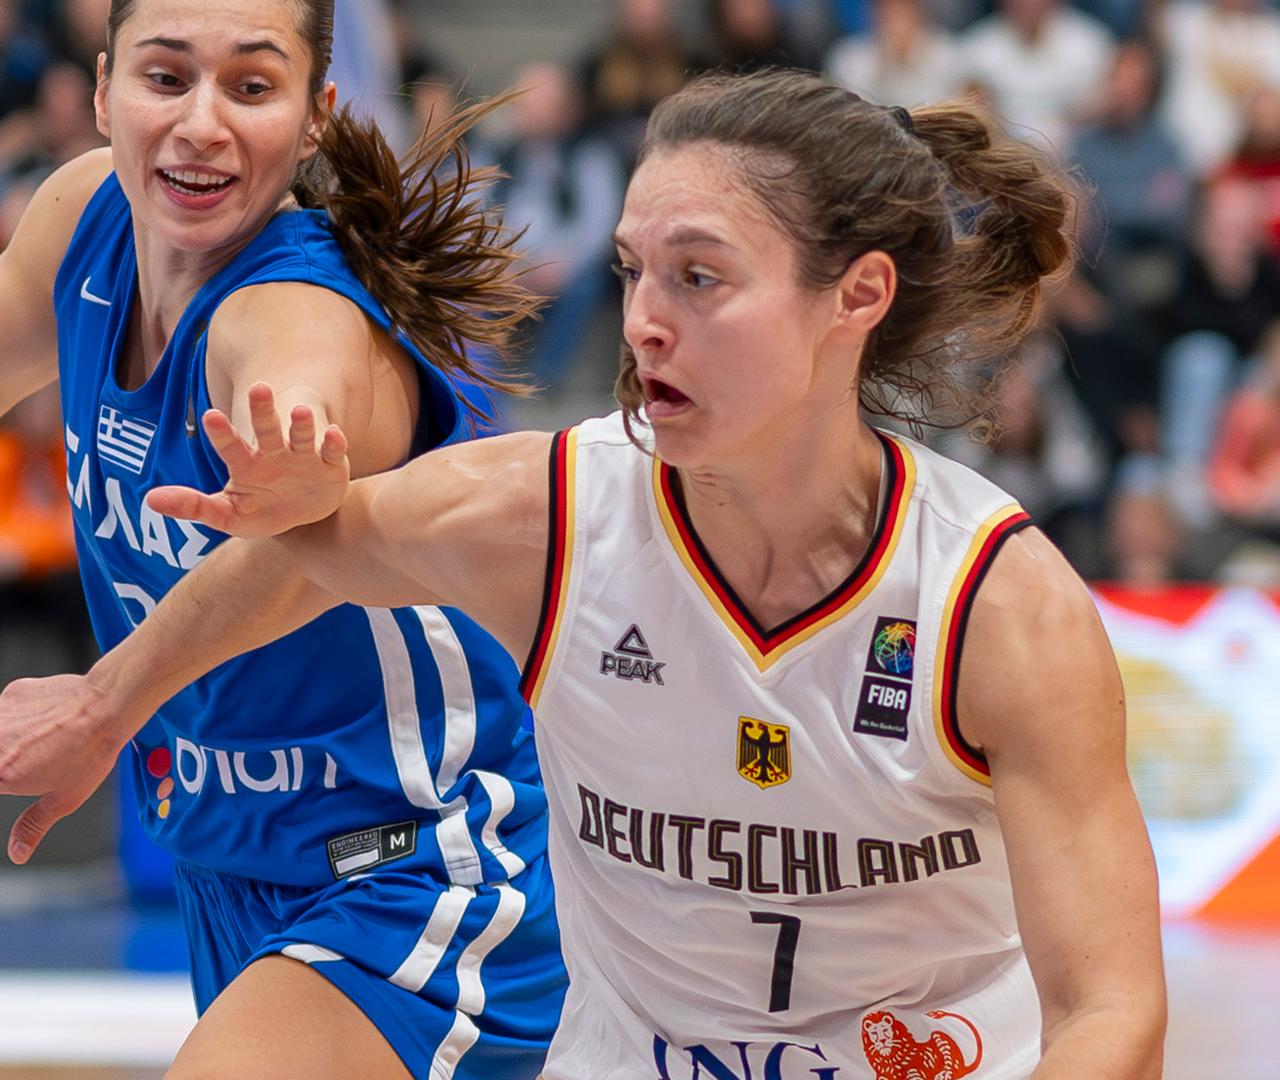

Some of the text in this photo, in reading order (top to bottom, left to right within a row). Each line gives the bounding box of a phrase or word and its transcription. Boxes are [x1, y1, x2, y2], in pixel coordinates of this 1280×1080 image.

[599, 650, 667, 686] PEAK
[867, 684, 908, 711] FIBA
[389, 832, 406, 850] M
[576, 782, 982, 896] DEUTSCHLAND
[749, 911, 802, 1013] 7
